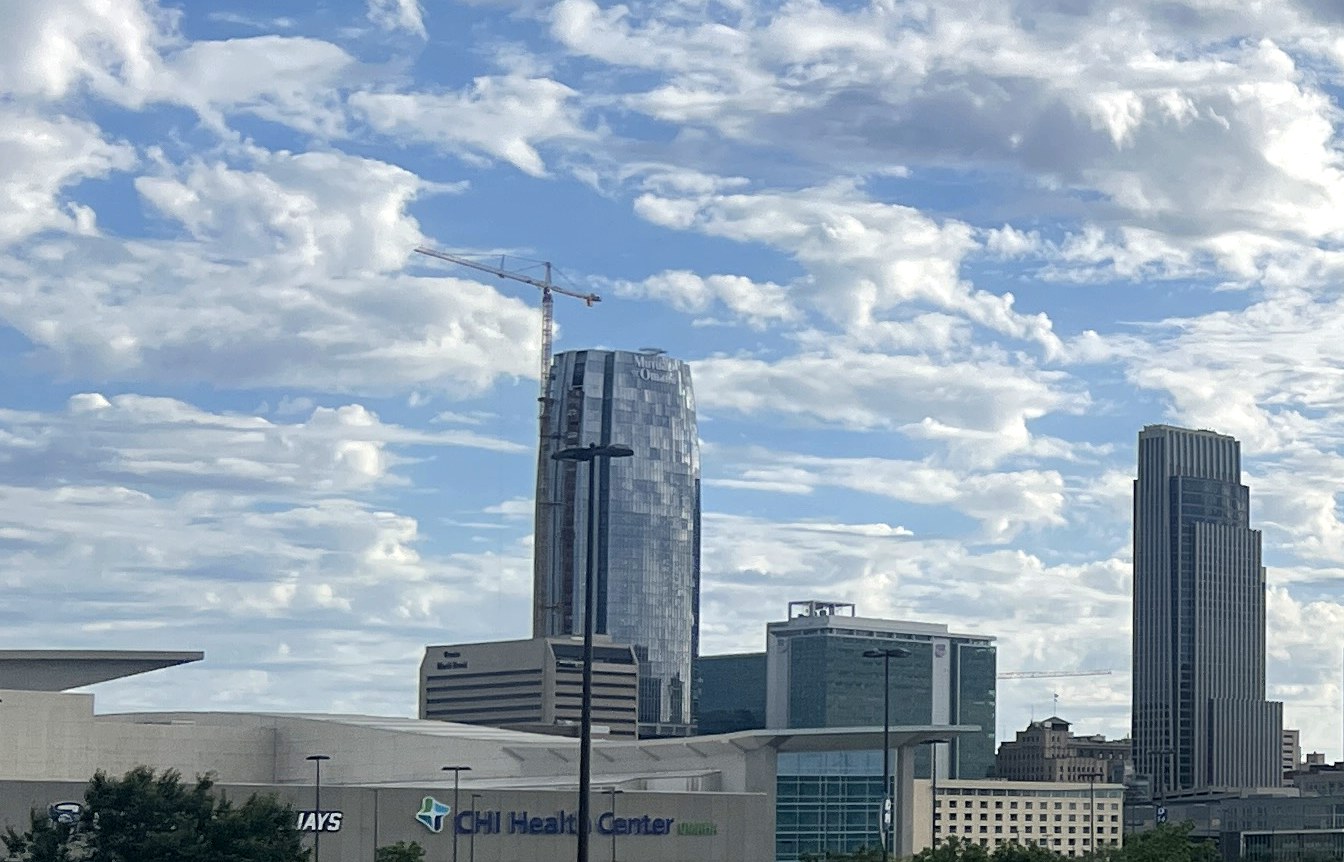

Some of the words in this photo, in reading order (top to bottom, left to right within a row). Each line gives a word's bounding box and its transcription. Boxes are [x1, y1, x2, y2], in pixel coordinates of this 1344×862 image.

[455, 810, 500, 834] CHI
[508, 810, 592, 834] Healt
[598, 811, 674, 835] Center
